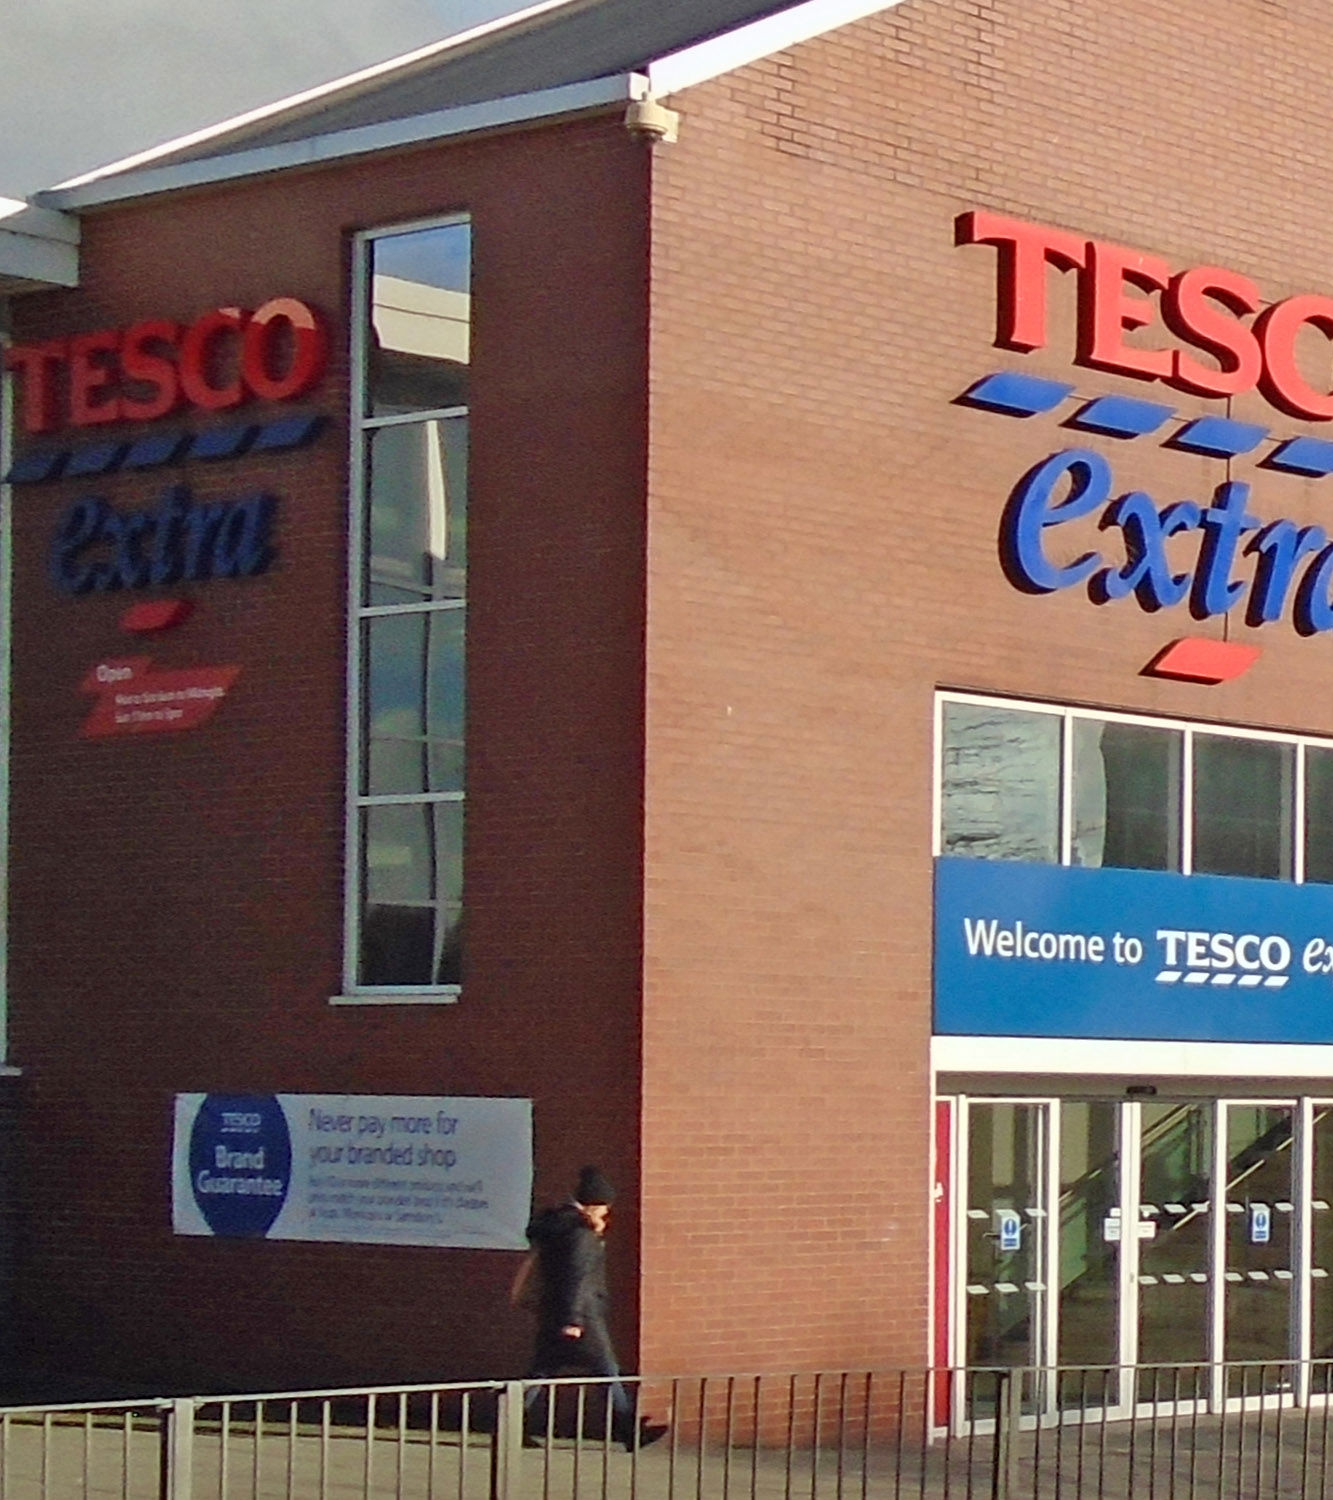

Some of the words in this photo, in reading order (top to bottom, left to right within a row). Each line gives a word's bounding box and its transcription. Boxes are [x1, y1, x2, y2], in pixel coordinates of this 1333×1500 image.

[5, 297, 326, 434] TESCO
[50, 485, 277, 596] extra
[964, 917, 1106, 962] Welcome
[1112, 931, 1143, 964] to
[1156, 929, 1291, 971] TESCO
[309, 1108, 353, 1132] Never
[357, 1113, 385, 1138] pay
[390, 1115, 433, 1135] more
[436, 1109, 459, 1135] for
[215, 1145, 265, 1169] Brand
[309, 1145, 344, 1168] your
[347, 1142, 413, 1166] branded
[416, 1142, 458, 1172] shop
[198, 1169, 284, 1196] Guarantee
